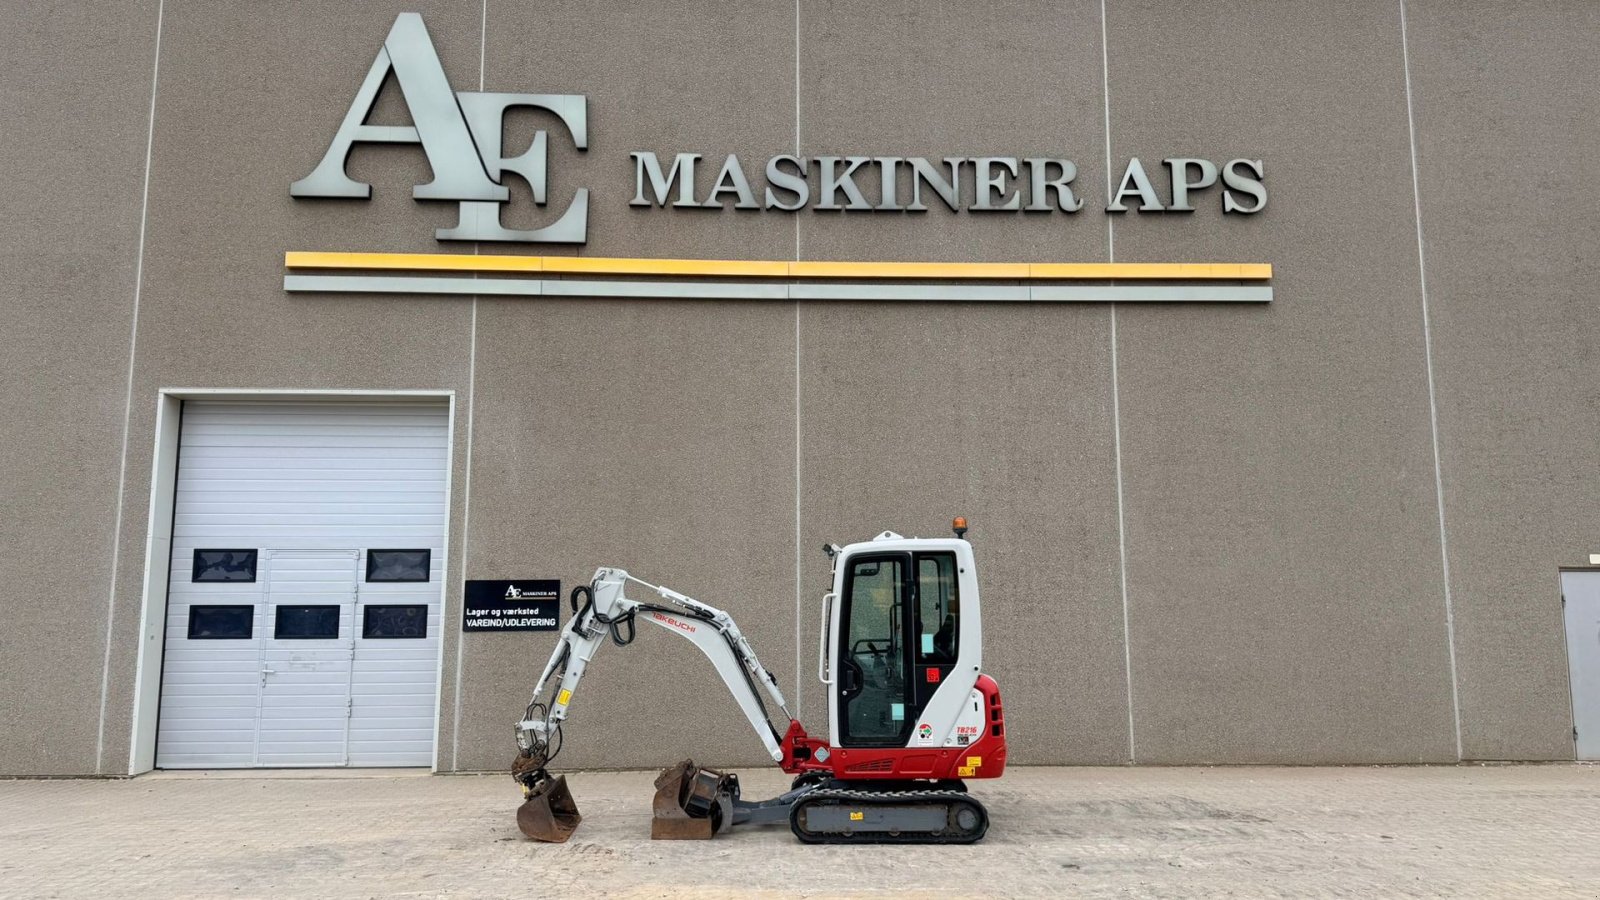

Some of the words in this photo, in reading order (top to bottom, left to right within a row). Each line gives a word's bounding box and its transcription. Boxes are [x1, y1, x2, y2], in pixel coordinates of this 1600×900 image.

[290, 12, 589, 243] AE
[629, 151, 1084, 214] MASKINER
[1106, 157, 1268, 215] APS
[466, 608, 489, 616] Lager
[466, 618, 556, 627] VAREIND/UDLEVERING
